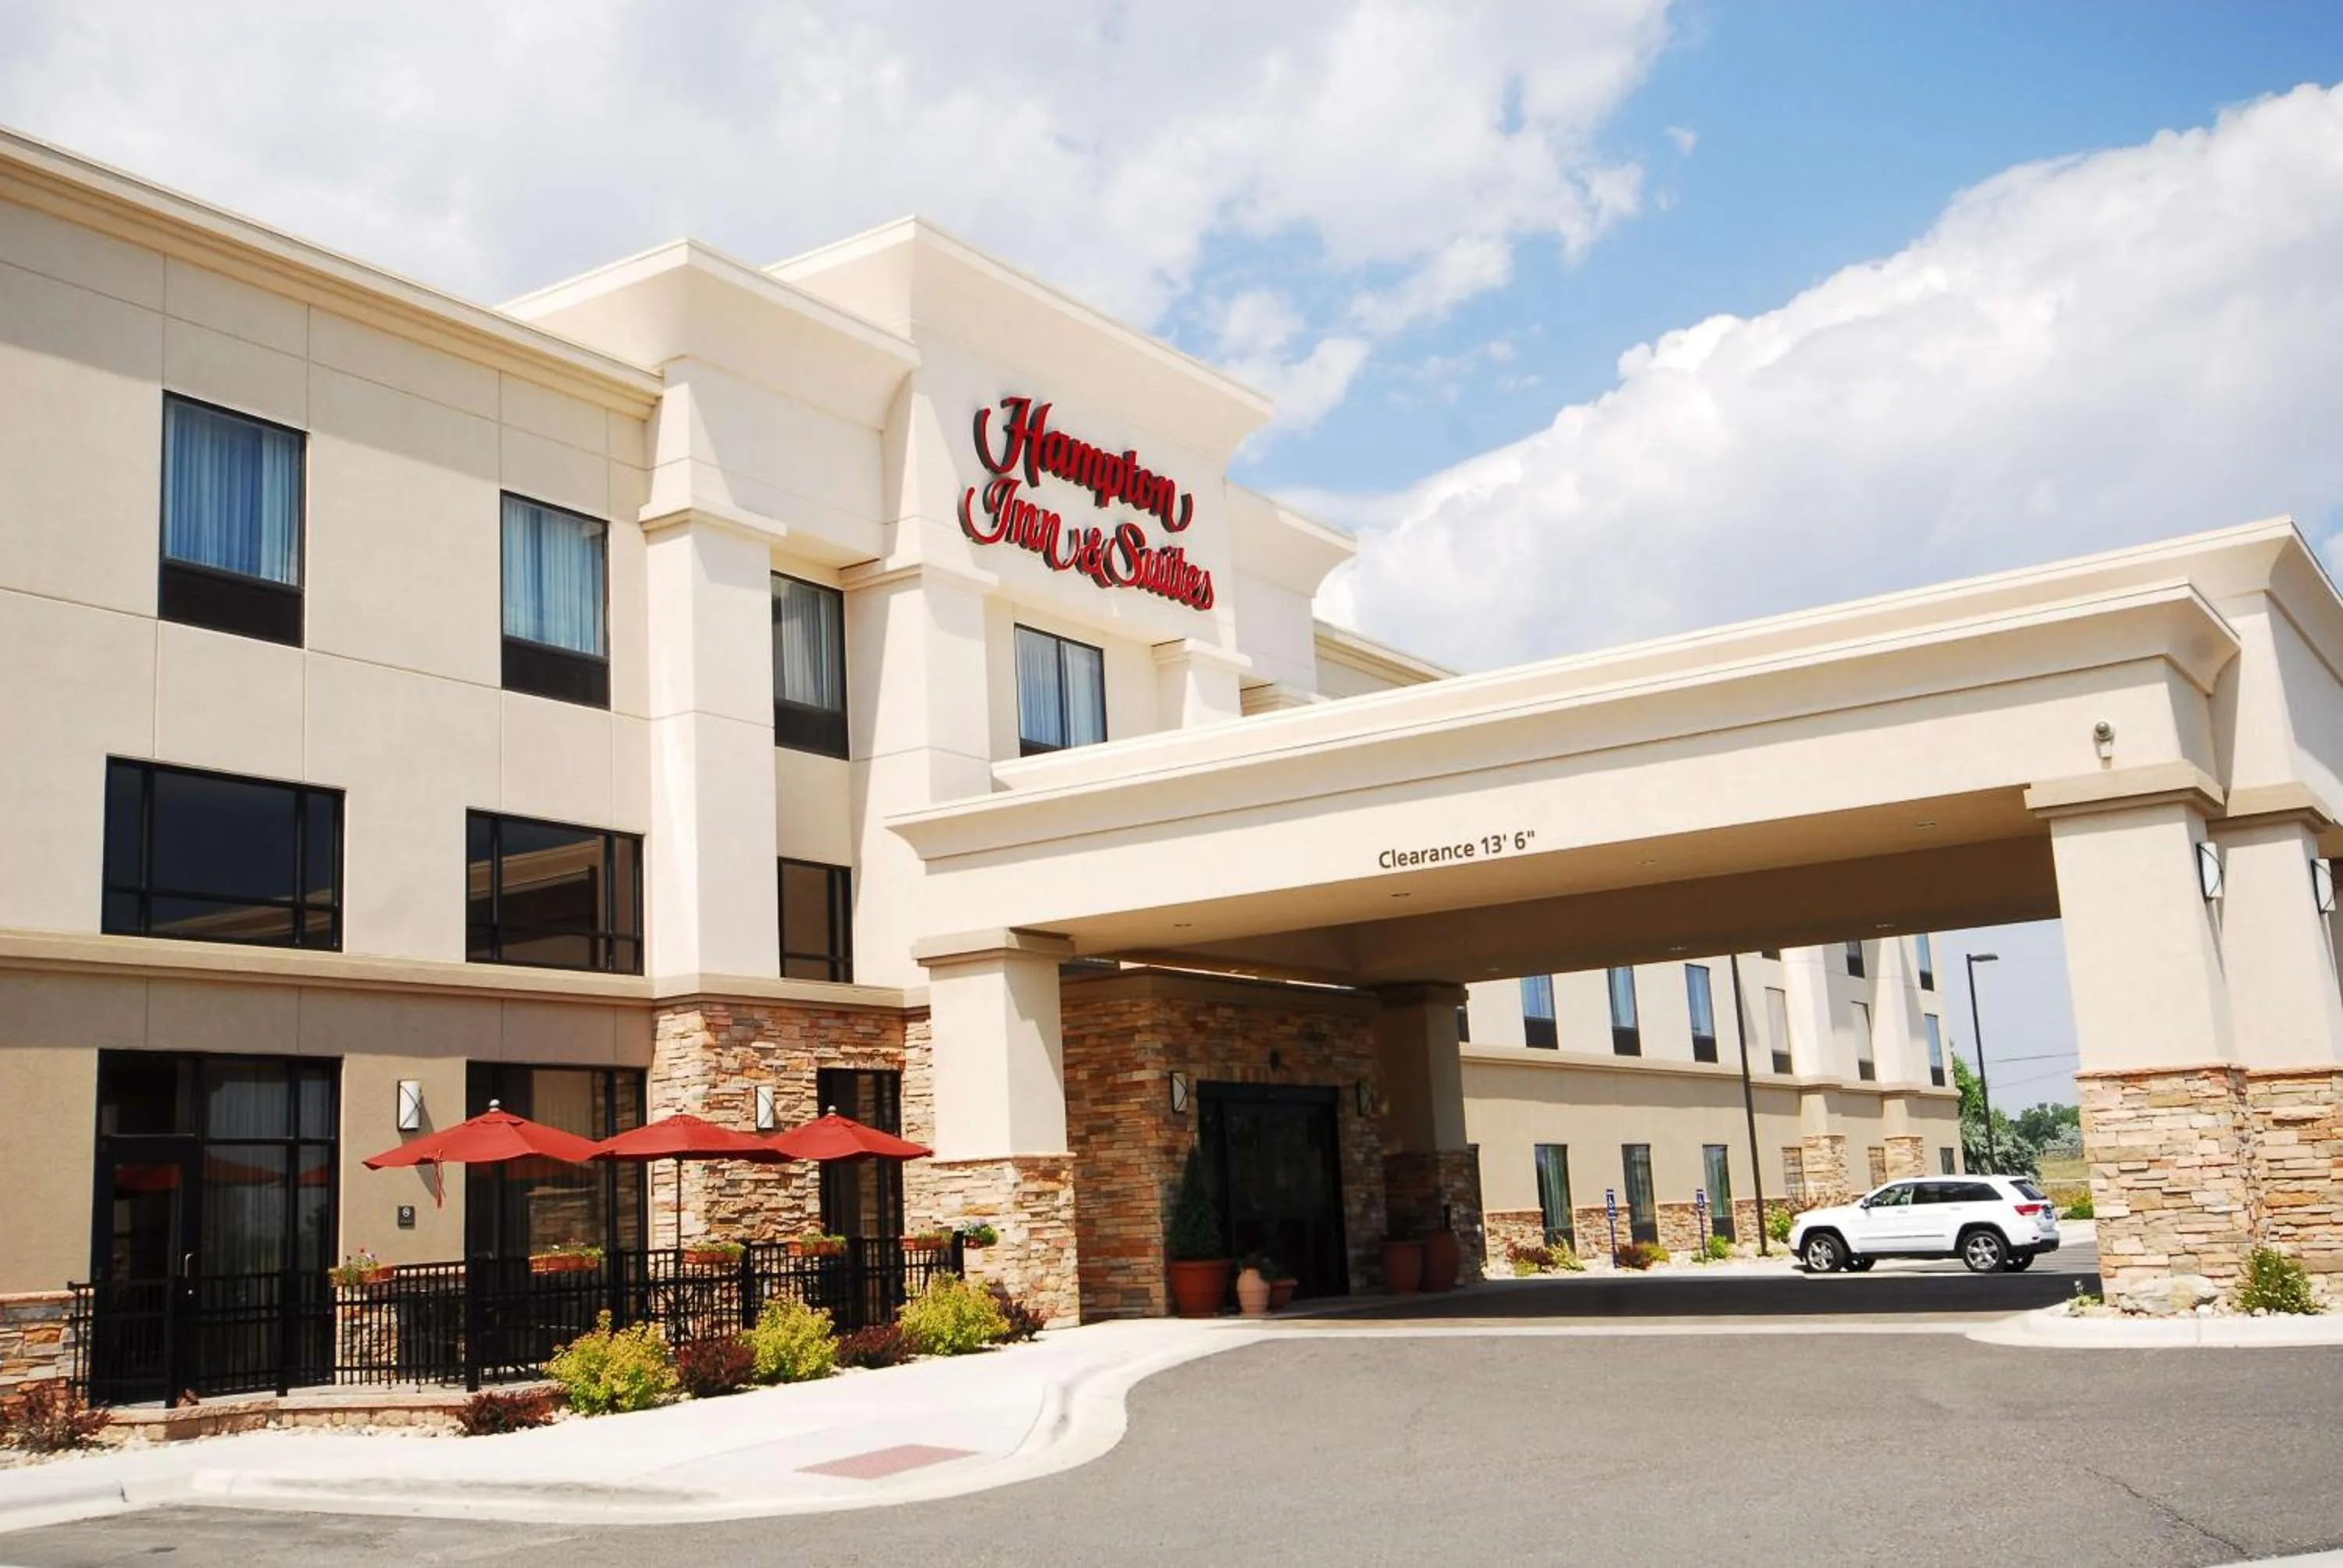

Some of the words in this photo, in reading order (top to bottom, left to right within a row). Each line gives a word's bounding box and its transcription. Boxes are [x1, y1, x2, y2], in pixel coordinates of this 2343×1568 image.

[973, 397, 1193, 533] Hampton
[958, 477, 1081, 571] Inn
[1079, 528, 1112, 588] &
[1102, 522, 1214, 611] Suites
[1378, 843, 1475, 868] Clearance
[1481, 835, 1507, 855] 13'
[1514, 830, 1535, 850] 6"
